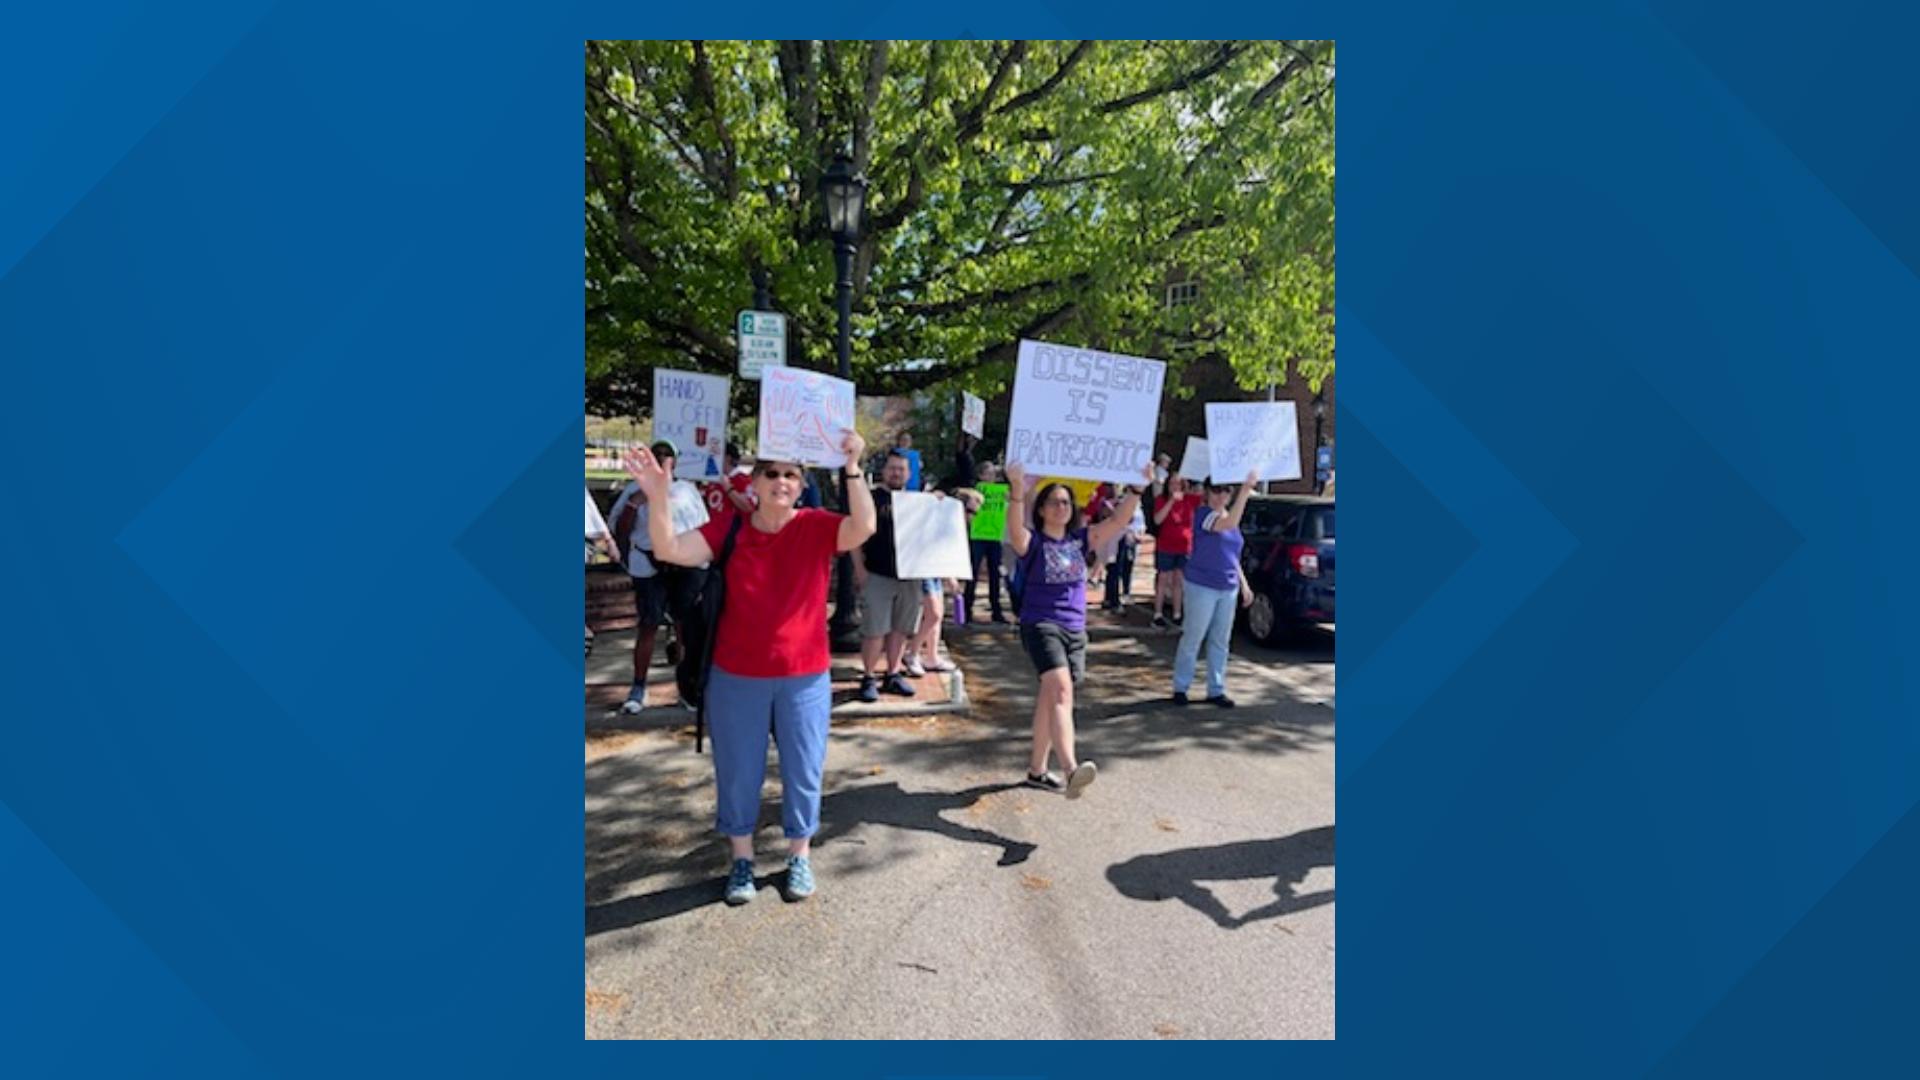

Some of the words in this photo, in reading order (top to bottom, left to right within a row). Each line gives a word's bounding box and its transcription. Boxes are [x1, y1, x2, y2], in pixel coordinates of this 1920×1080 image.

[1032, 345, 1162, 393] DISSENT
[660, 377, 704, 402] HANDS
[1065, 389, 1108, 425] IS
[1013, 429, 1151, 472] PATRIOTIC
